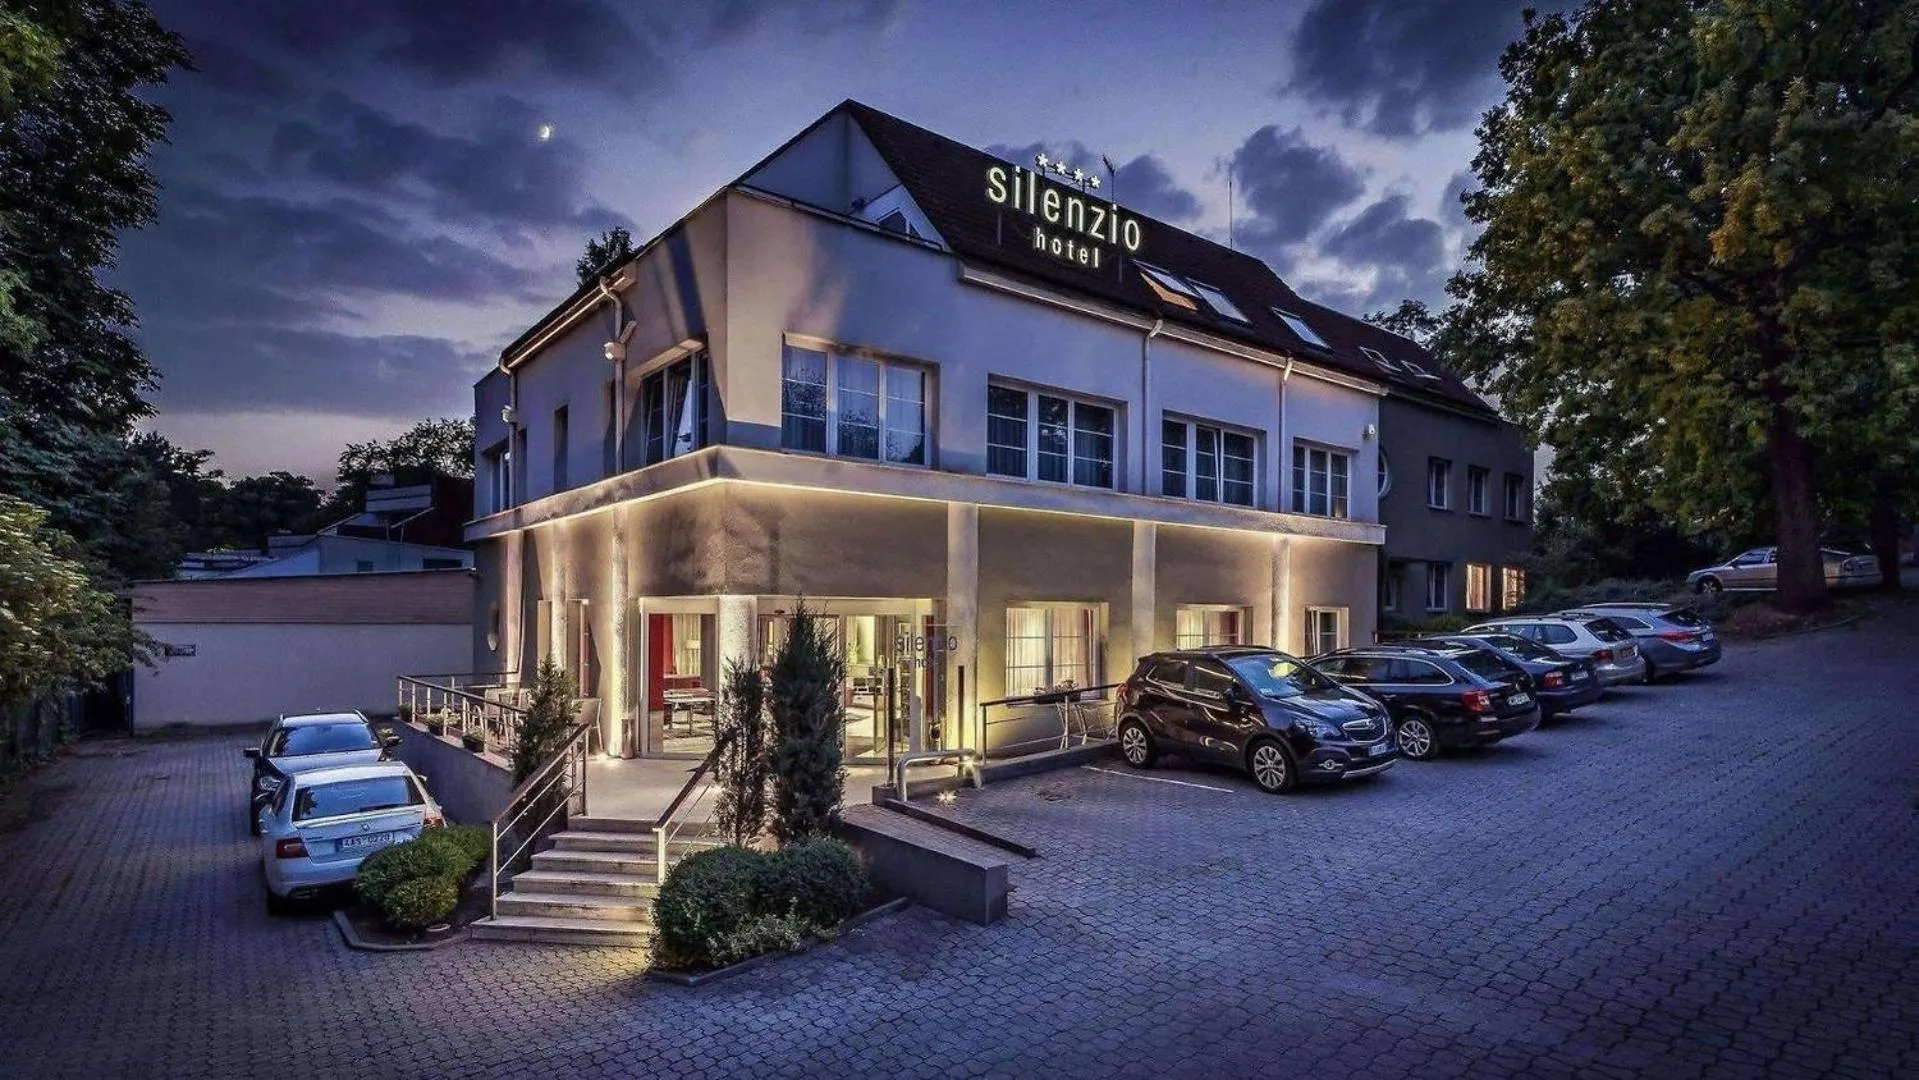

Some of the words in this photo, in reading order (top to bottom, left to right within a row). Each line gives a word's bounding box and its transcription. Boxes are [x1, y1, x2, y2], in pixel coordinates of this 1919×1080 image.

[987, 166, 1141, 251] silenzio
[1035, 226, 1099, 269] hotel
[896, 632, 958, 652] sileo
